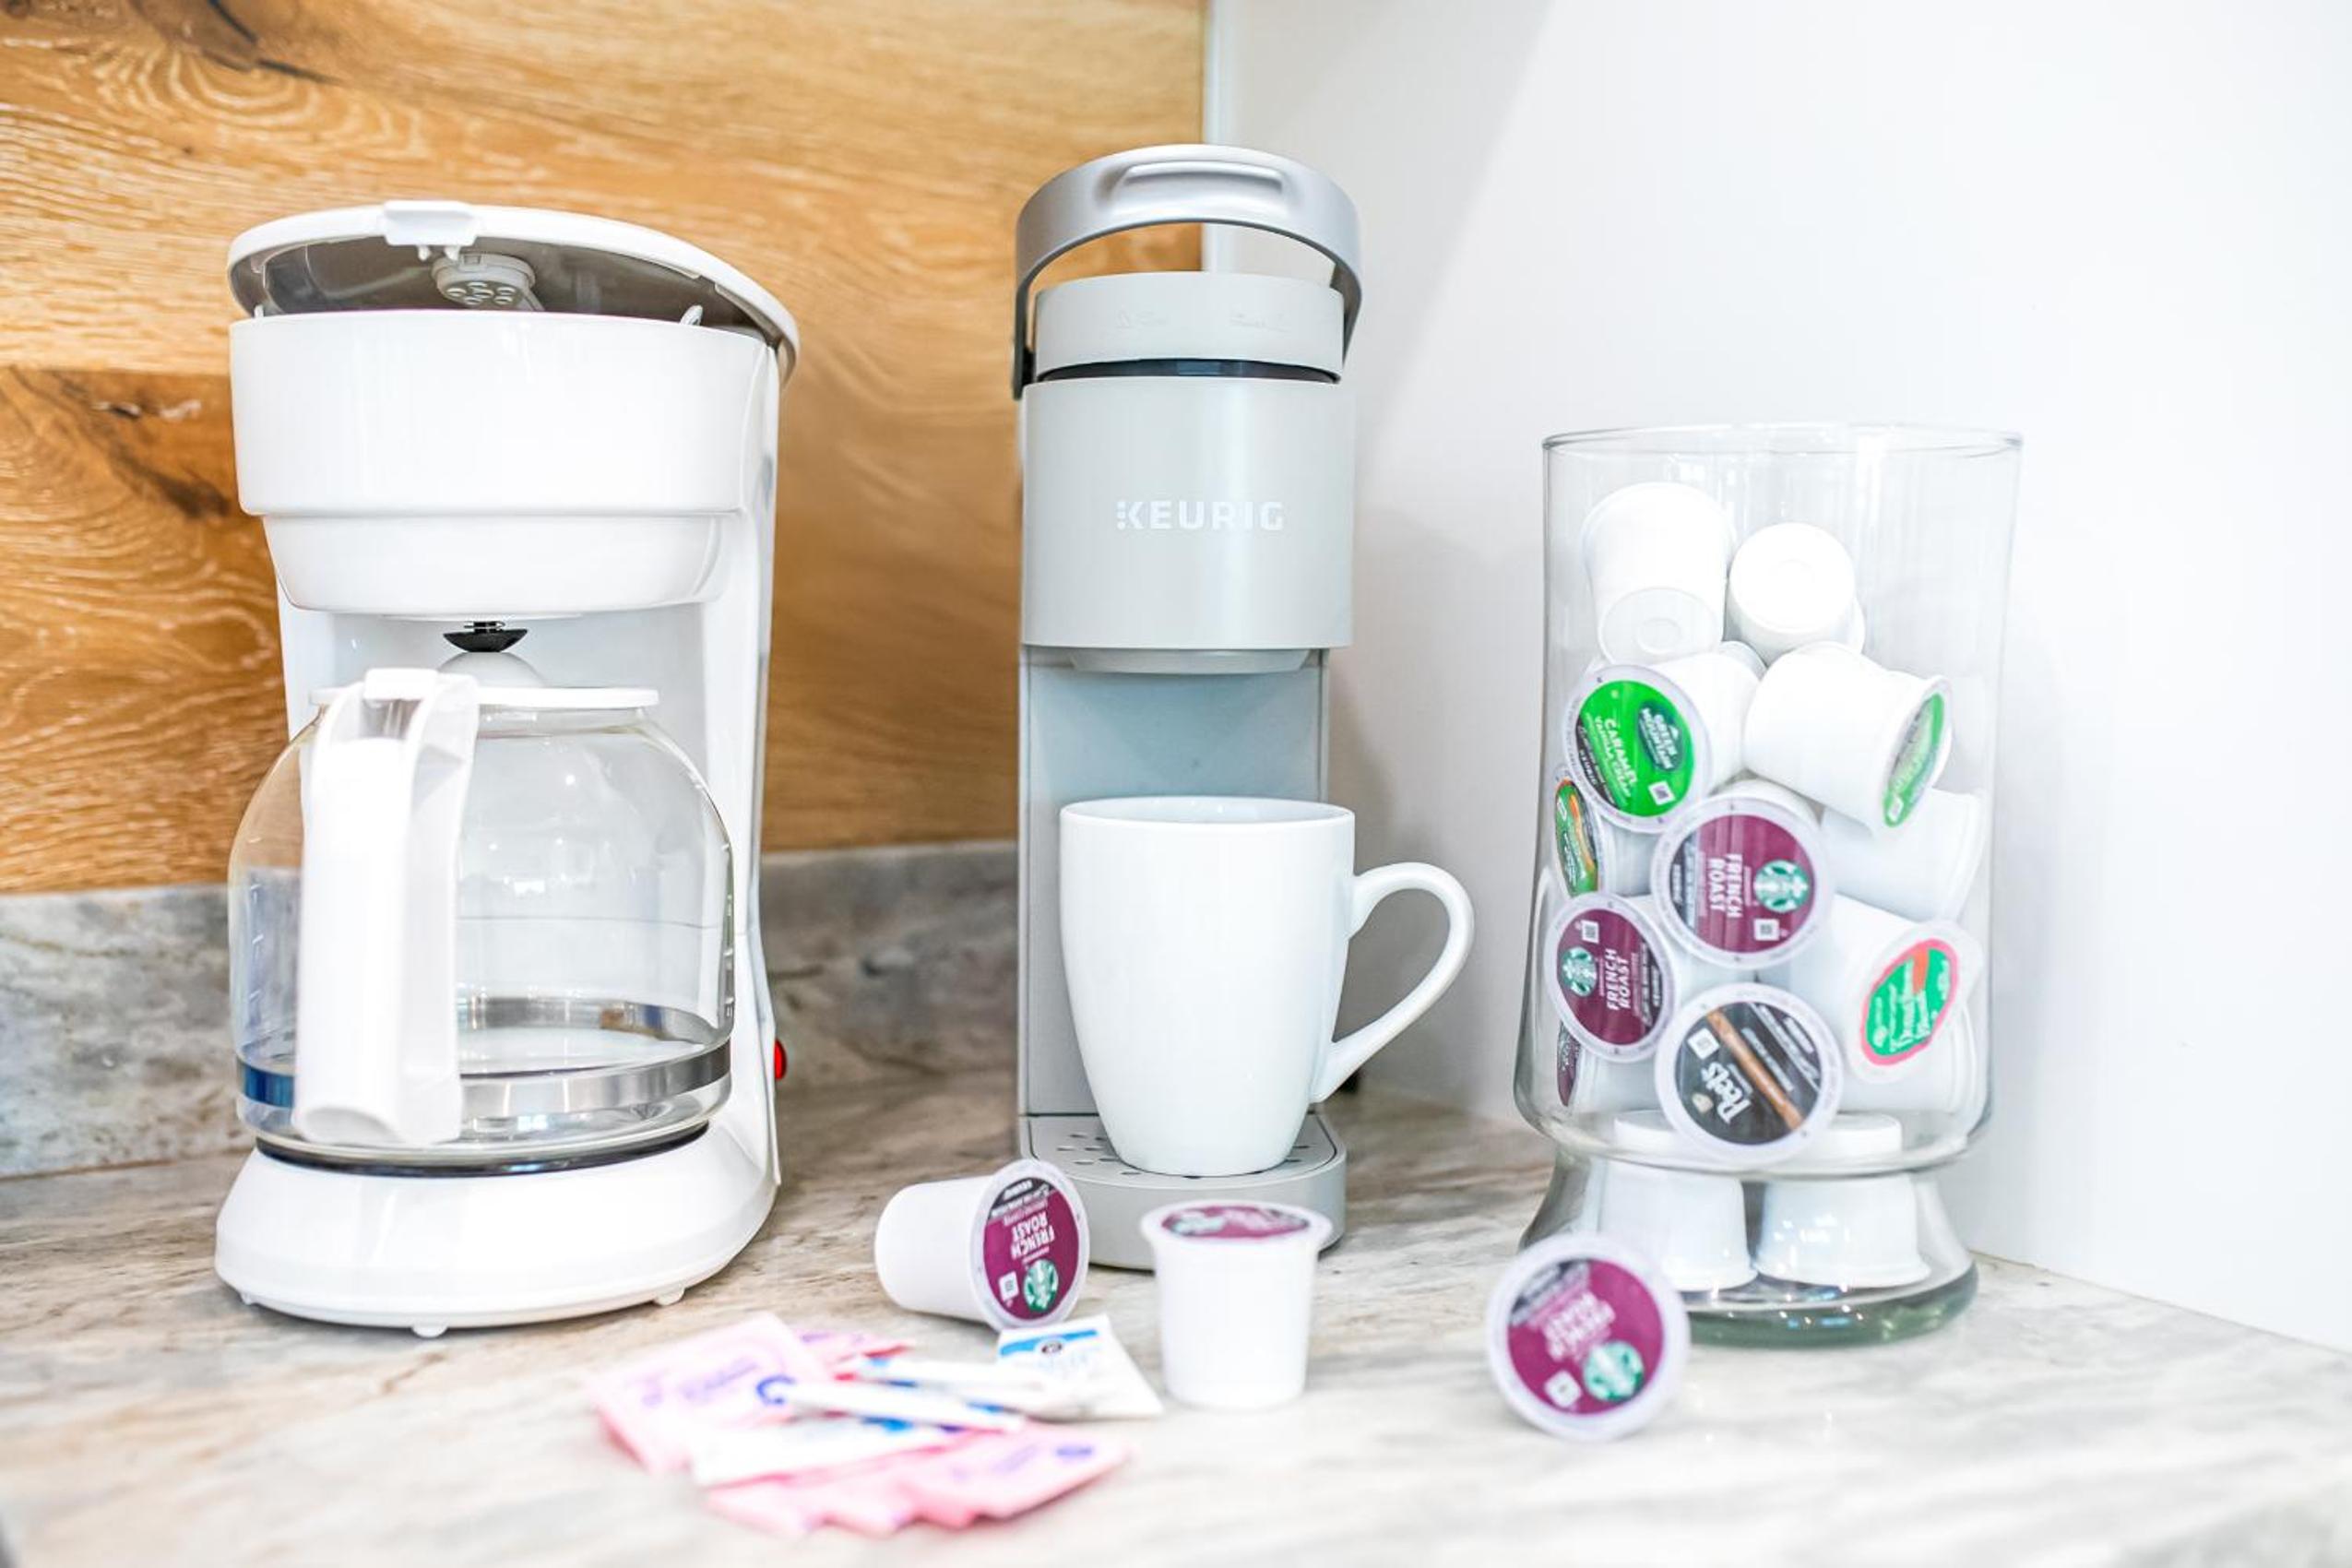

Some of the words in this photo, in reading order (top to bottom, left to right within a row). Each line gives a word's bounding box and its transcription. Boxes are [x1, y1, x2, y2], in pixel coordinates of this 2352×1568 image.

[1116, 500, 1284, 531] KEURIG
[1707, 858, 1726, 911] ROAST
[1725, 853, 1743, 918] FRENCH
[1605, 948, 1621, 1011] FRENCH
[1616, 956, 1631, 1010] ROAST
[1010, 1224, 1055, 1261] FRENCH
[1012, 1210, 1050, 1242] ROAST
